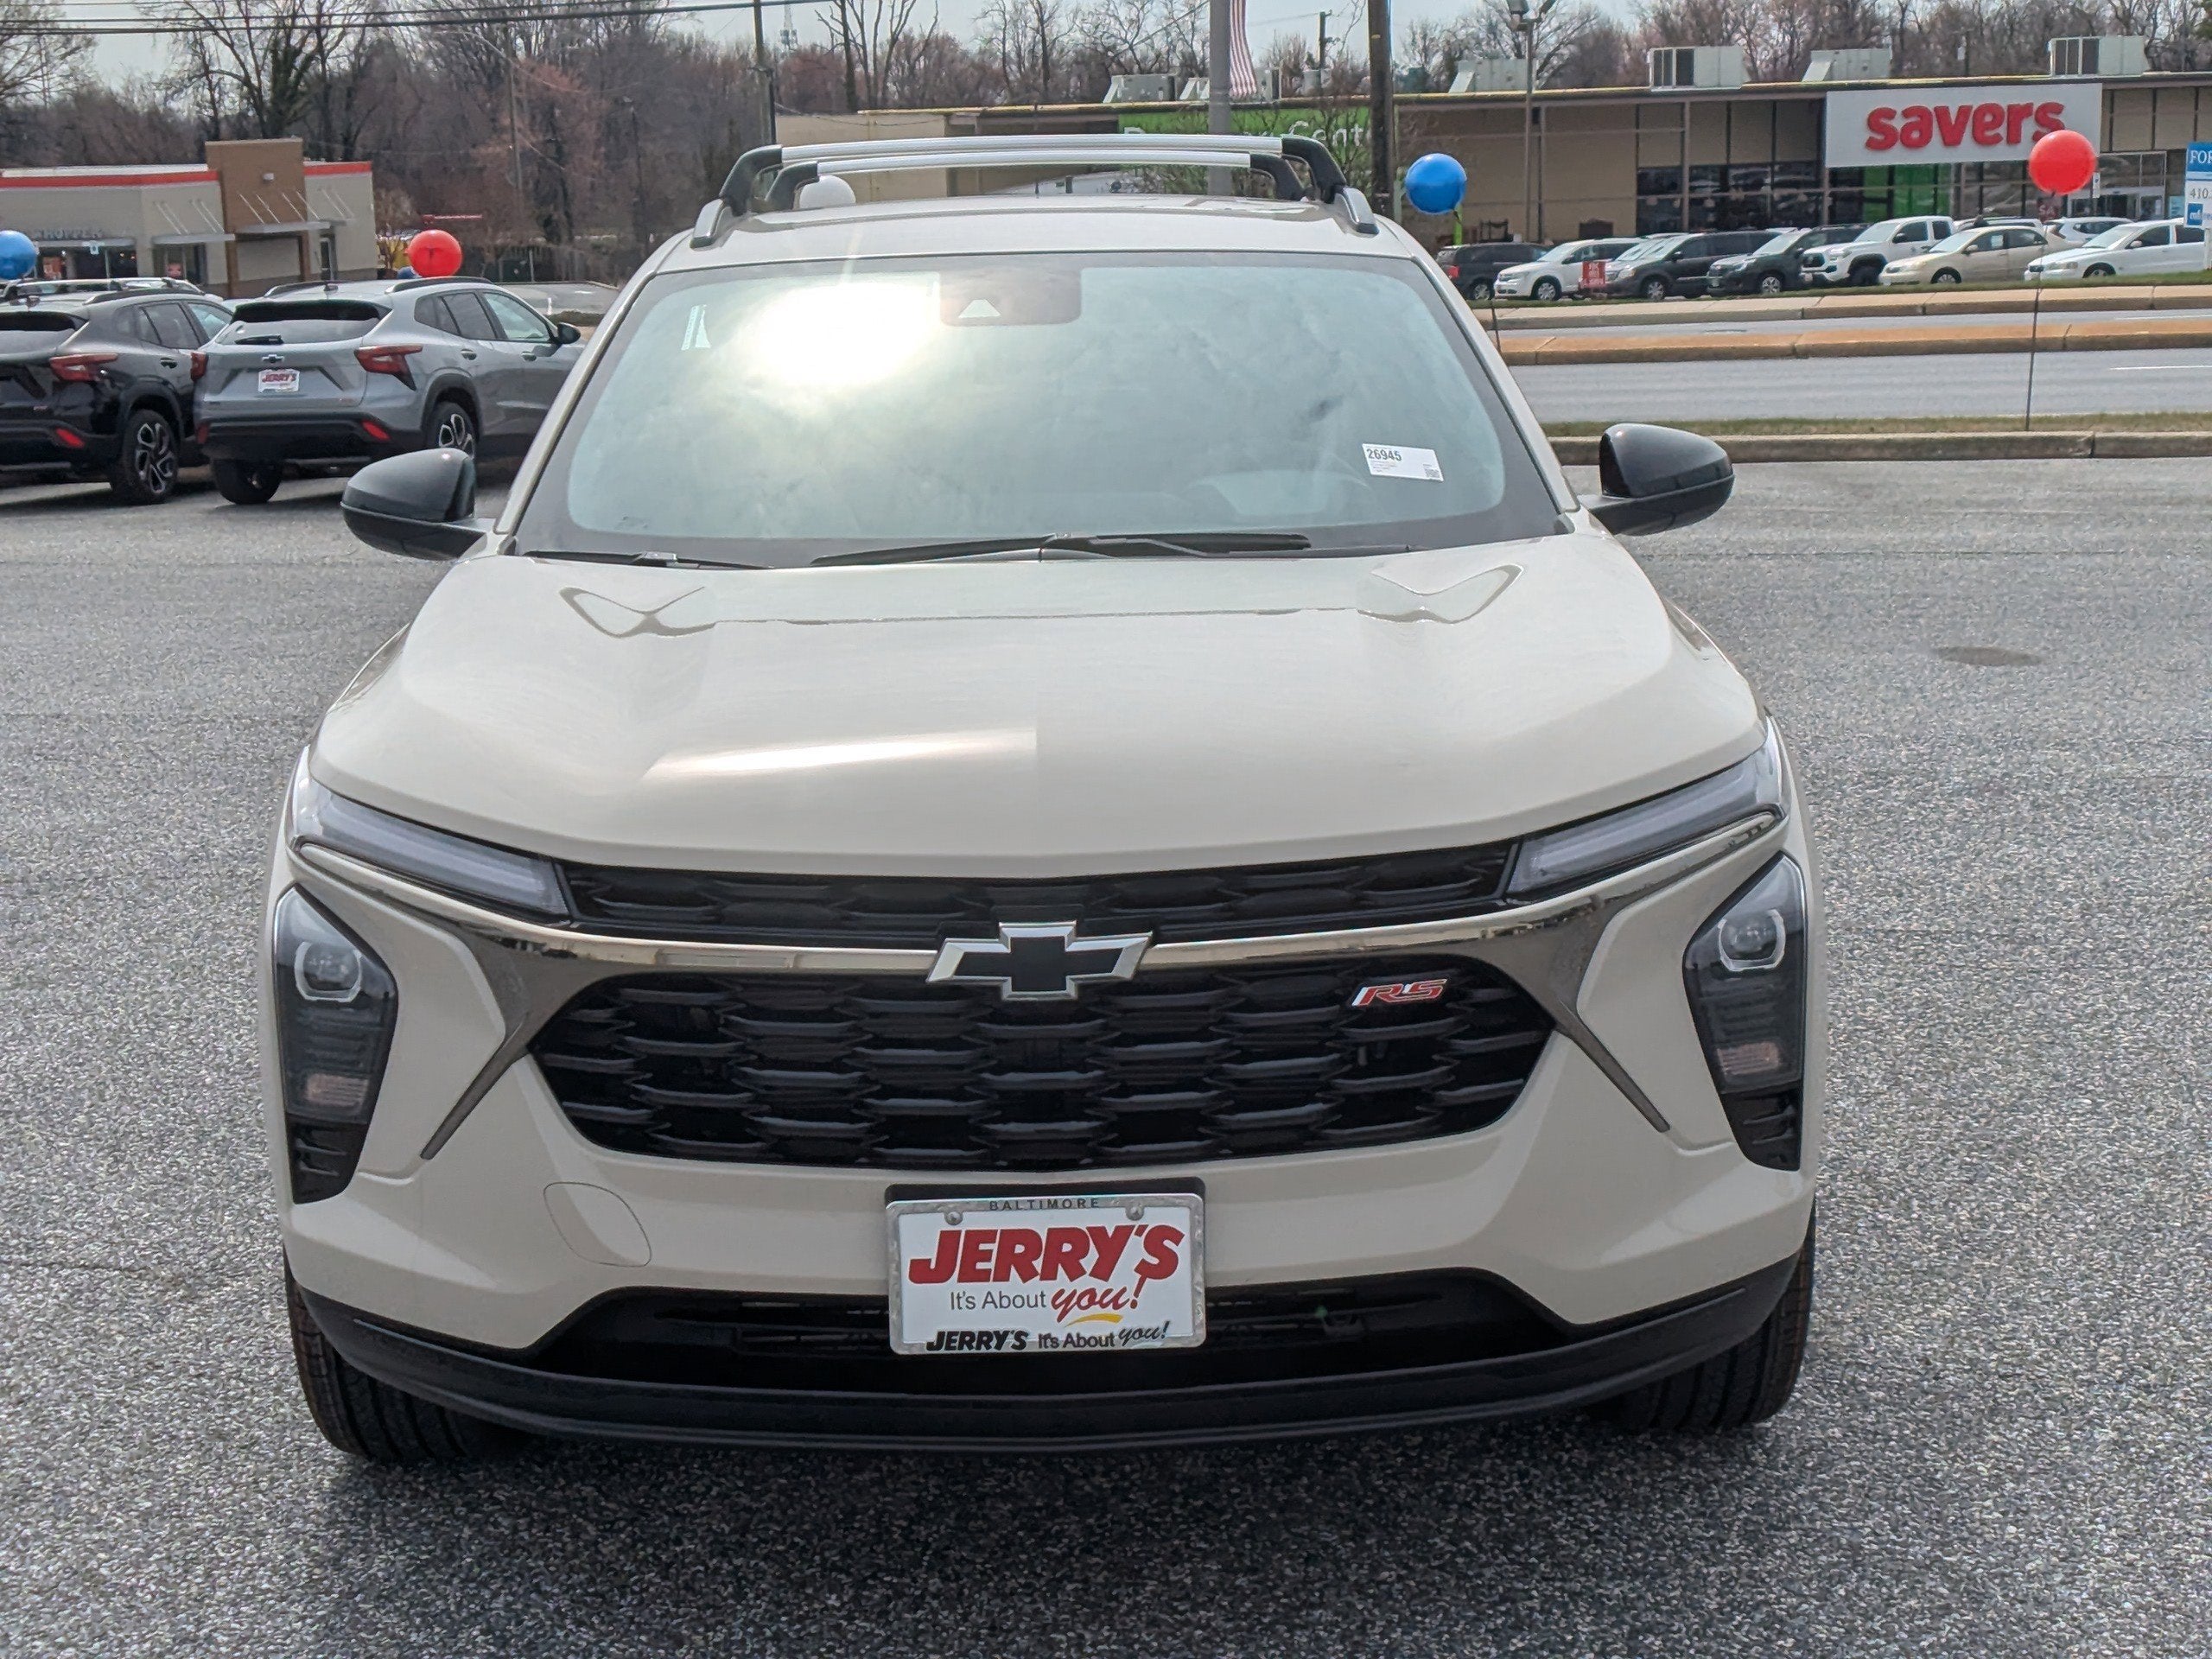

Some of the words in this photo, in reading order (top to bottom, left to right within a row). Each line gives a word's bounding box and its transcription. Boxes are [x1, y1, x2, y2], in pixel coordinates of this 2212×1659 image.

[1865, 102, 2066, 152] savers
[1366, 448, 1402, 461] 26945
[1351, 978, 1447, 1007] RS
[989, 1198, 1099, 1211] BALTIMORE
[908, 1224, 1185, 1284] JERRY'S
[950, 1291, 976, 1310] It's
[983, 1290, 1046, 1309] About
[1051, 1274, 1147, 1323] you!
[926, 1330, 1029, 1351] JERRY'S
[1039, 1334, 1059, 1349] It's
[1063, 1332, 1115, 1348] About
[1118, 1320, 1171, 1344] you!
